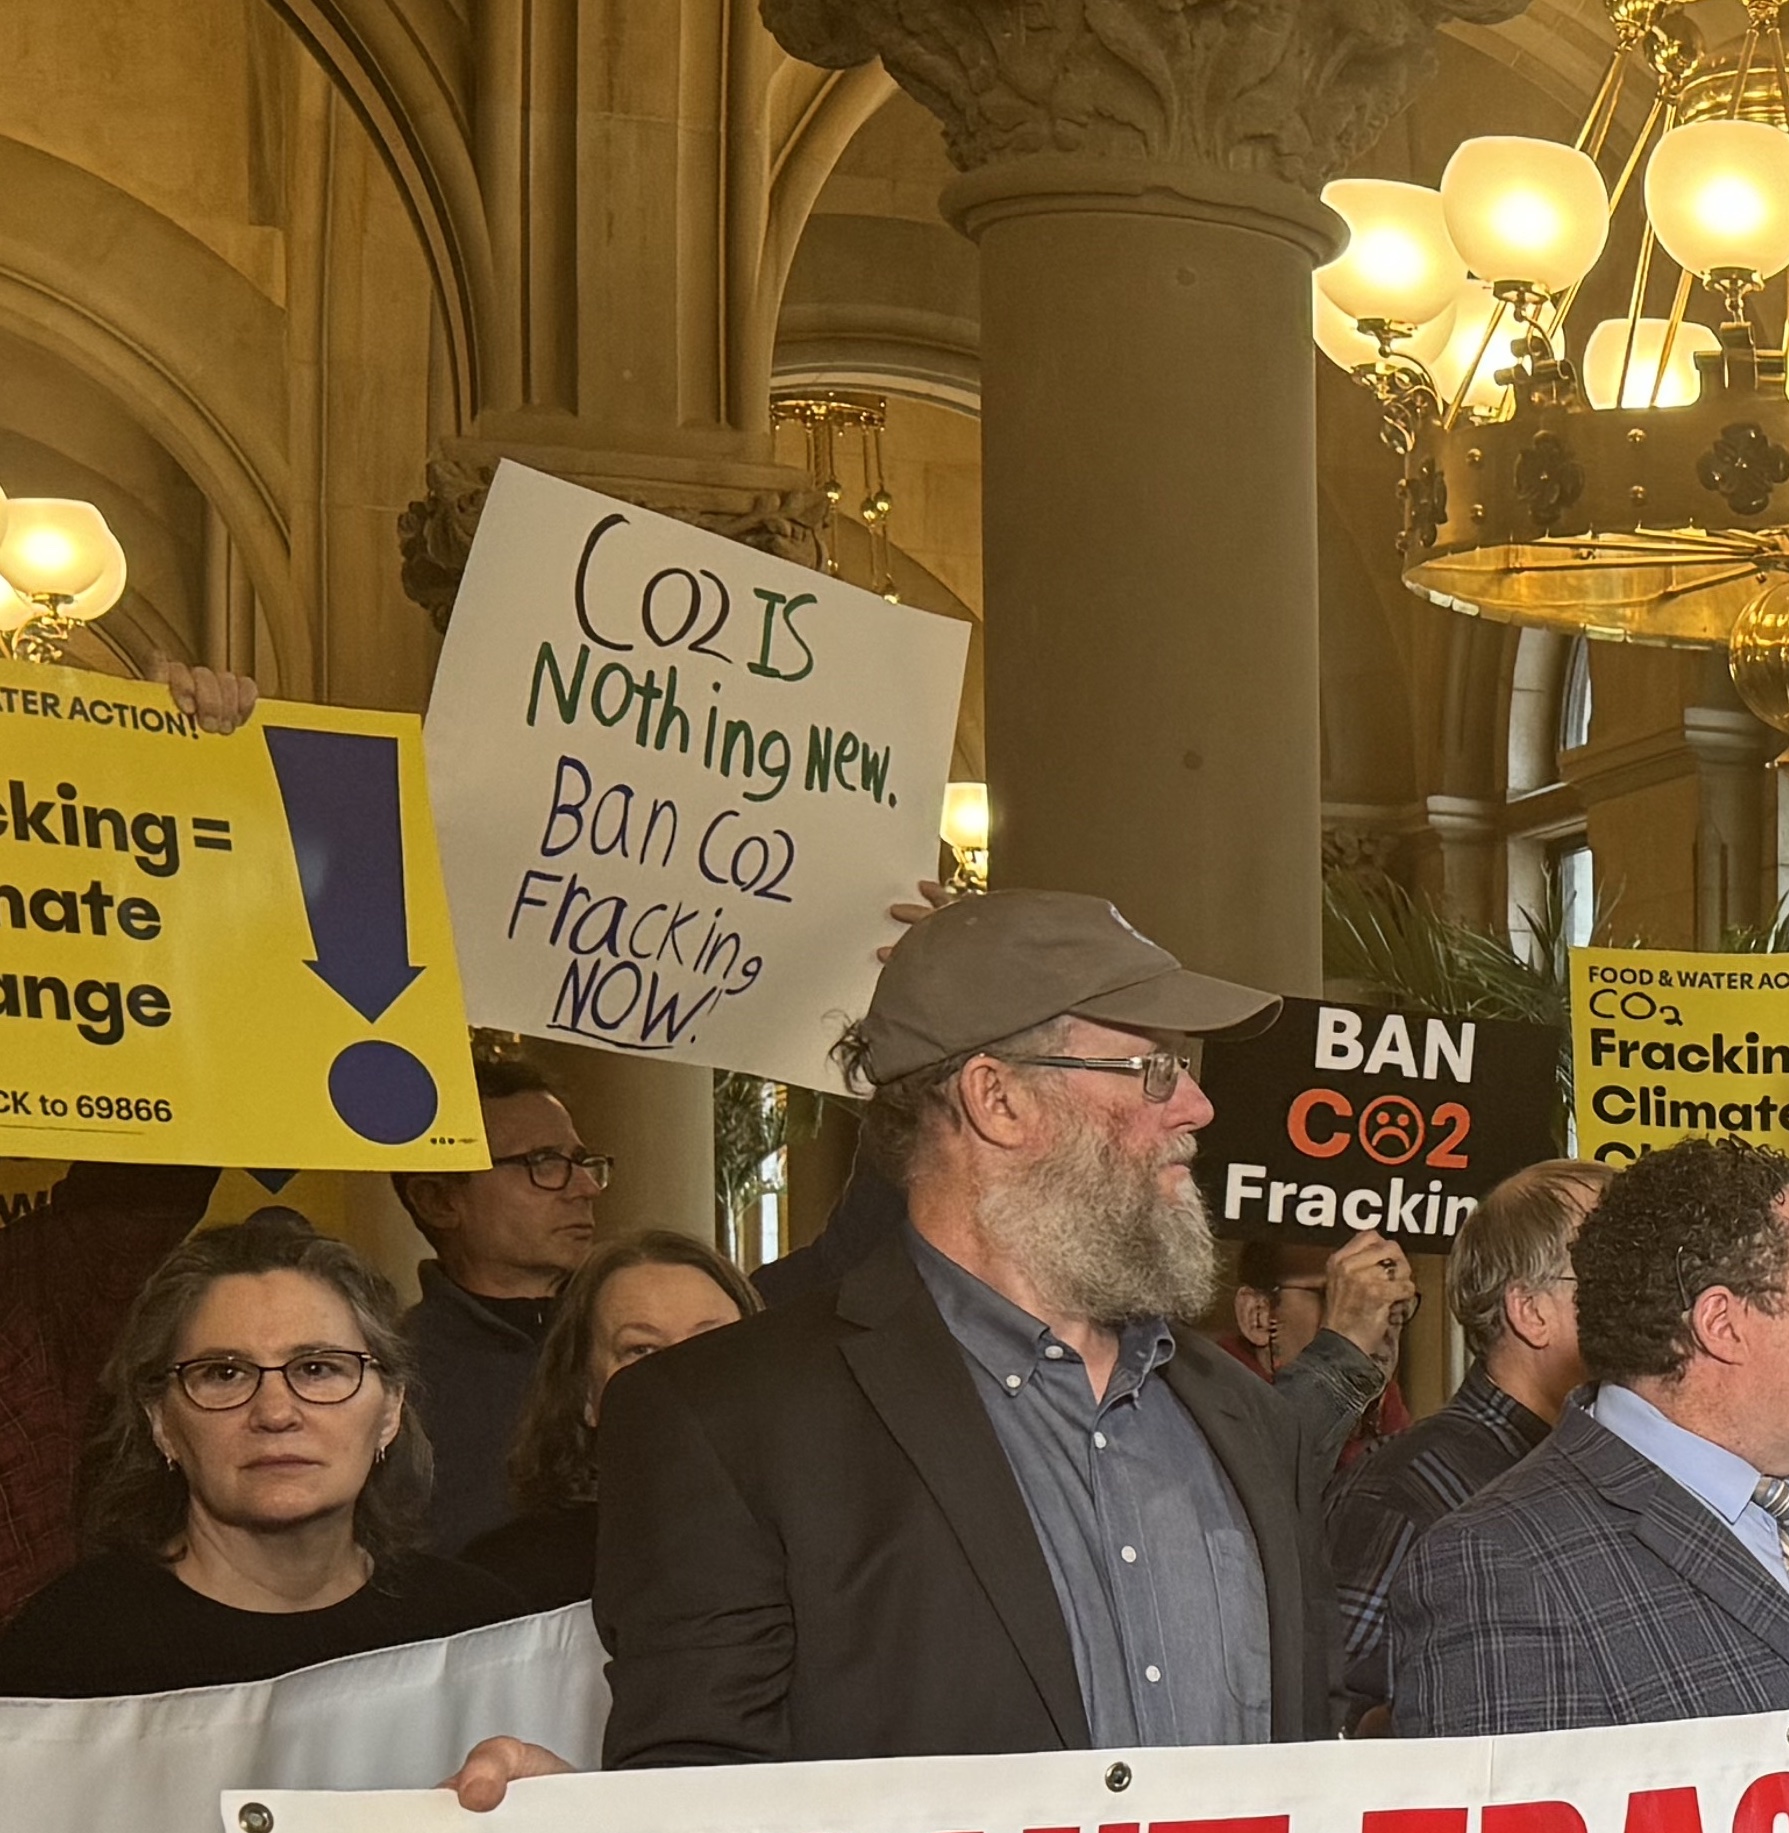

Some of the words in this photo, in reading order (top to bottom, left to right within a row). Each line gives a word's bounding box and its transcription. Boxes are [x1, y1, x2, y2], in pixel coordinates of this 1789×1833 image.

[747, 588, 818, 682] IS
[0, 687, 62, 719] TER
[68, 696, 199, 739] ACTION!
[541, 755, 677, 867] Ban
[508, 869, 763, 995] Fracking
[1588, 966, 1653, 985] FOOD
[1658, 969, 1674, 987] &
[1677, 971, 1753, 989] WATER
[1315, 1007, 1476, 1083] BAN
[40, 1095, 68, 1117] to
[76, 1095, 173, 1122] 69866
[1224, 1163, 1479, 1236] Frackin
